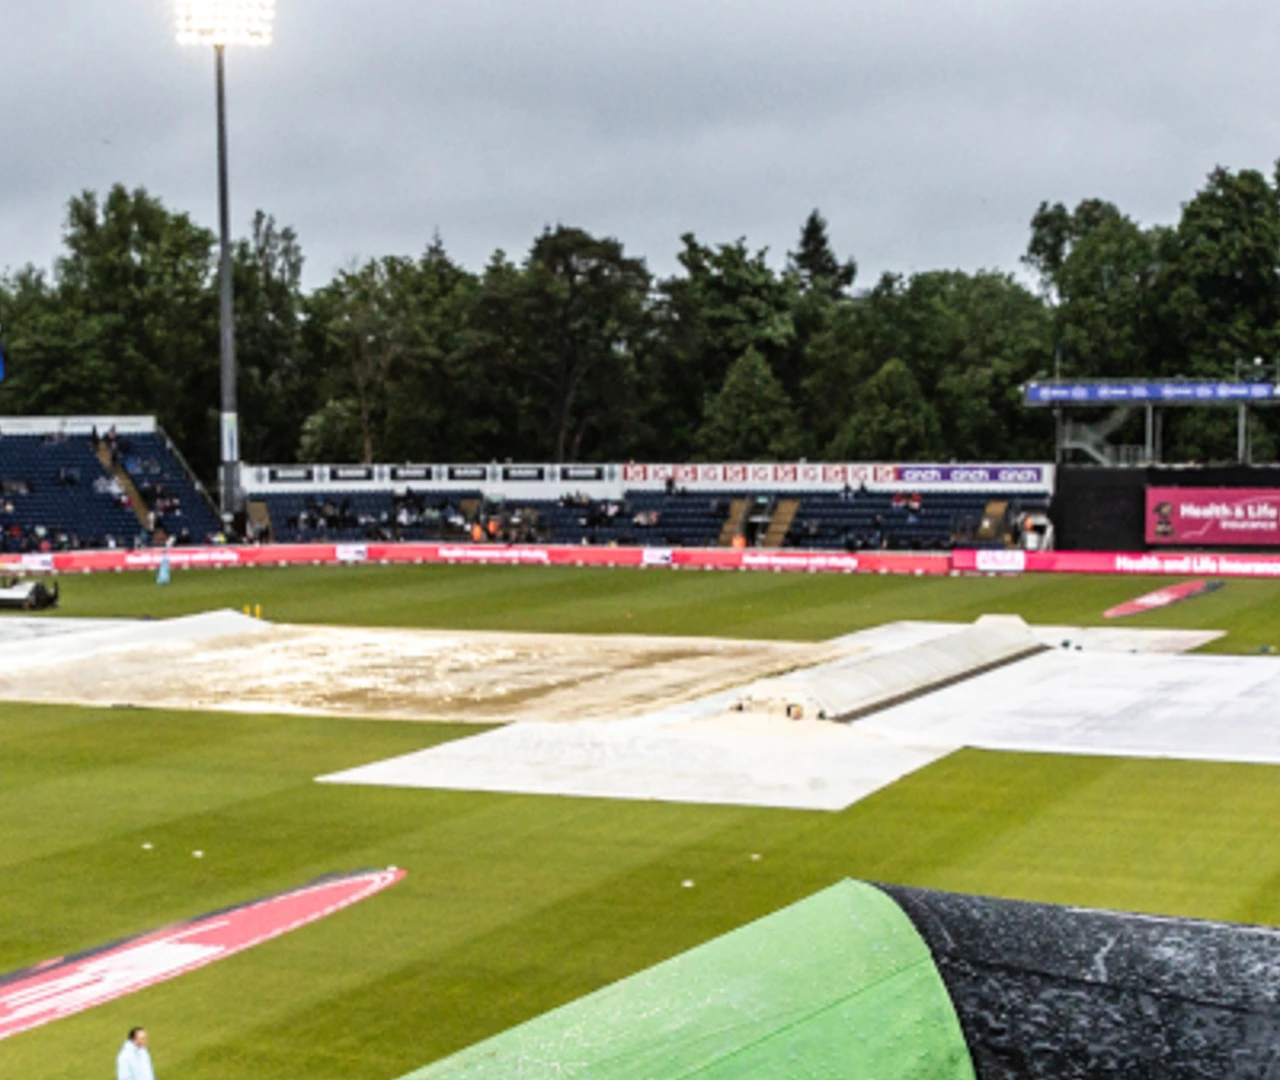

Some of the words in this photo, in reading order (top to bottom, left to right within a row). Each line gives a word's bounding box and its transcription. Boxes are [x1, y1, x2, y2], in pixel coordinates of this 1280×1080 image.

[904, 467, 941, 480] cinch
[950, 467, 989, 480] cinch
[998, 467, 1037, 480] cinch
[1180, 503, 1231, 518] Health
[1248, 503, 1277, 518] Life
[1116, 555, 1161, 570] Health
[1164, 557, 1190, 571] and
[1193, 557, 1217, 572] Life
